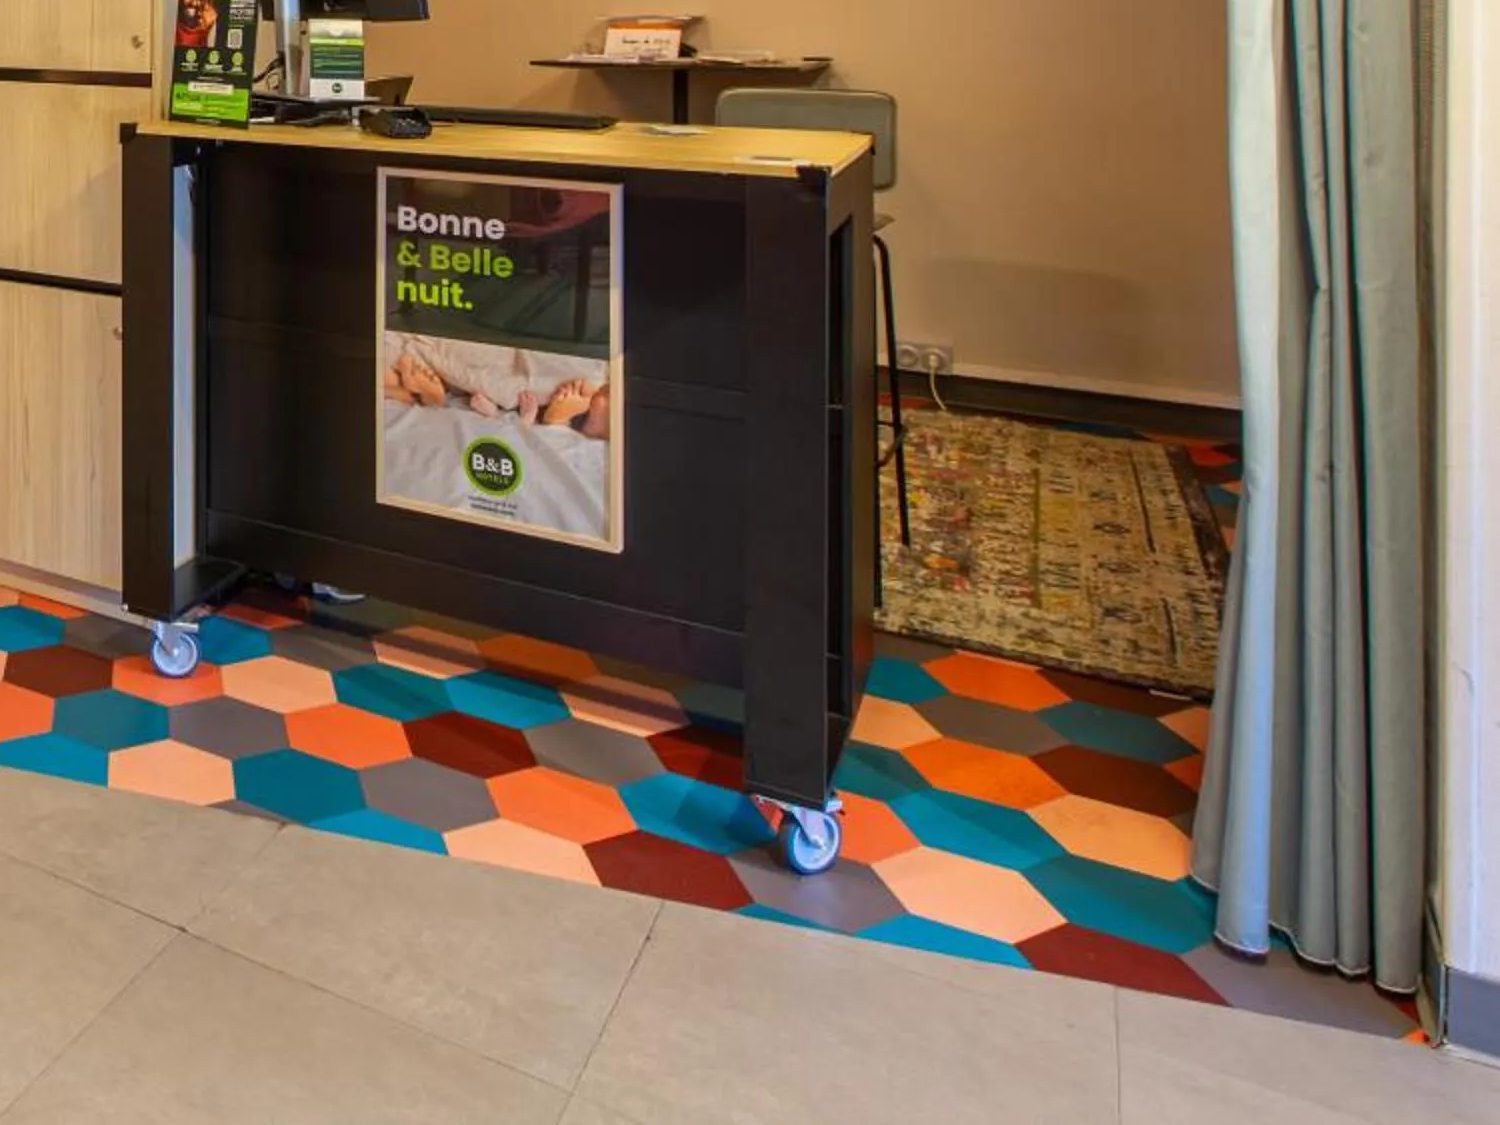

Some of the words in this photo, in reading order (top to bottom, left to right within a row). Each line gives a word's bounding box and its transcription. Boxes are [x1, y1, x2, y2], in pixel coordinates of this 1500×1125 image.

[398, 205, 505, 240] Bonne
[397, 241, 421, 268] &
[431, 244, 514, 278] Belle
[397, 278, 474, 311] nuit.
[472, 453, 515, 476] B&B
